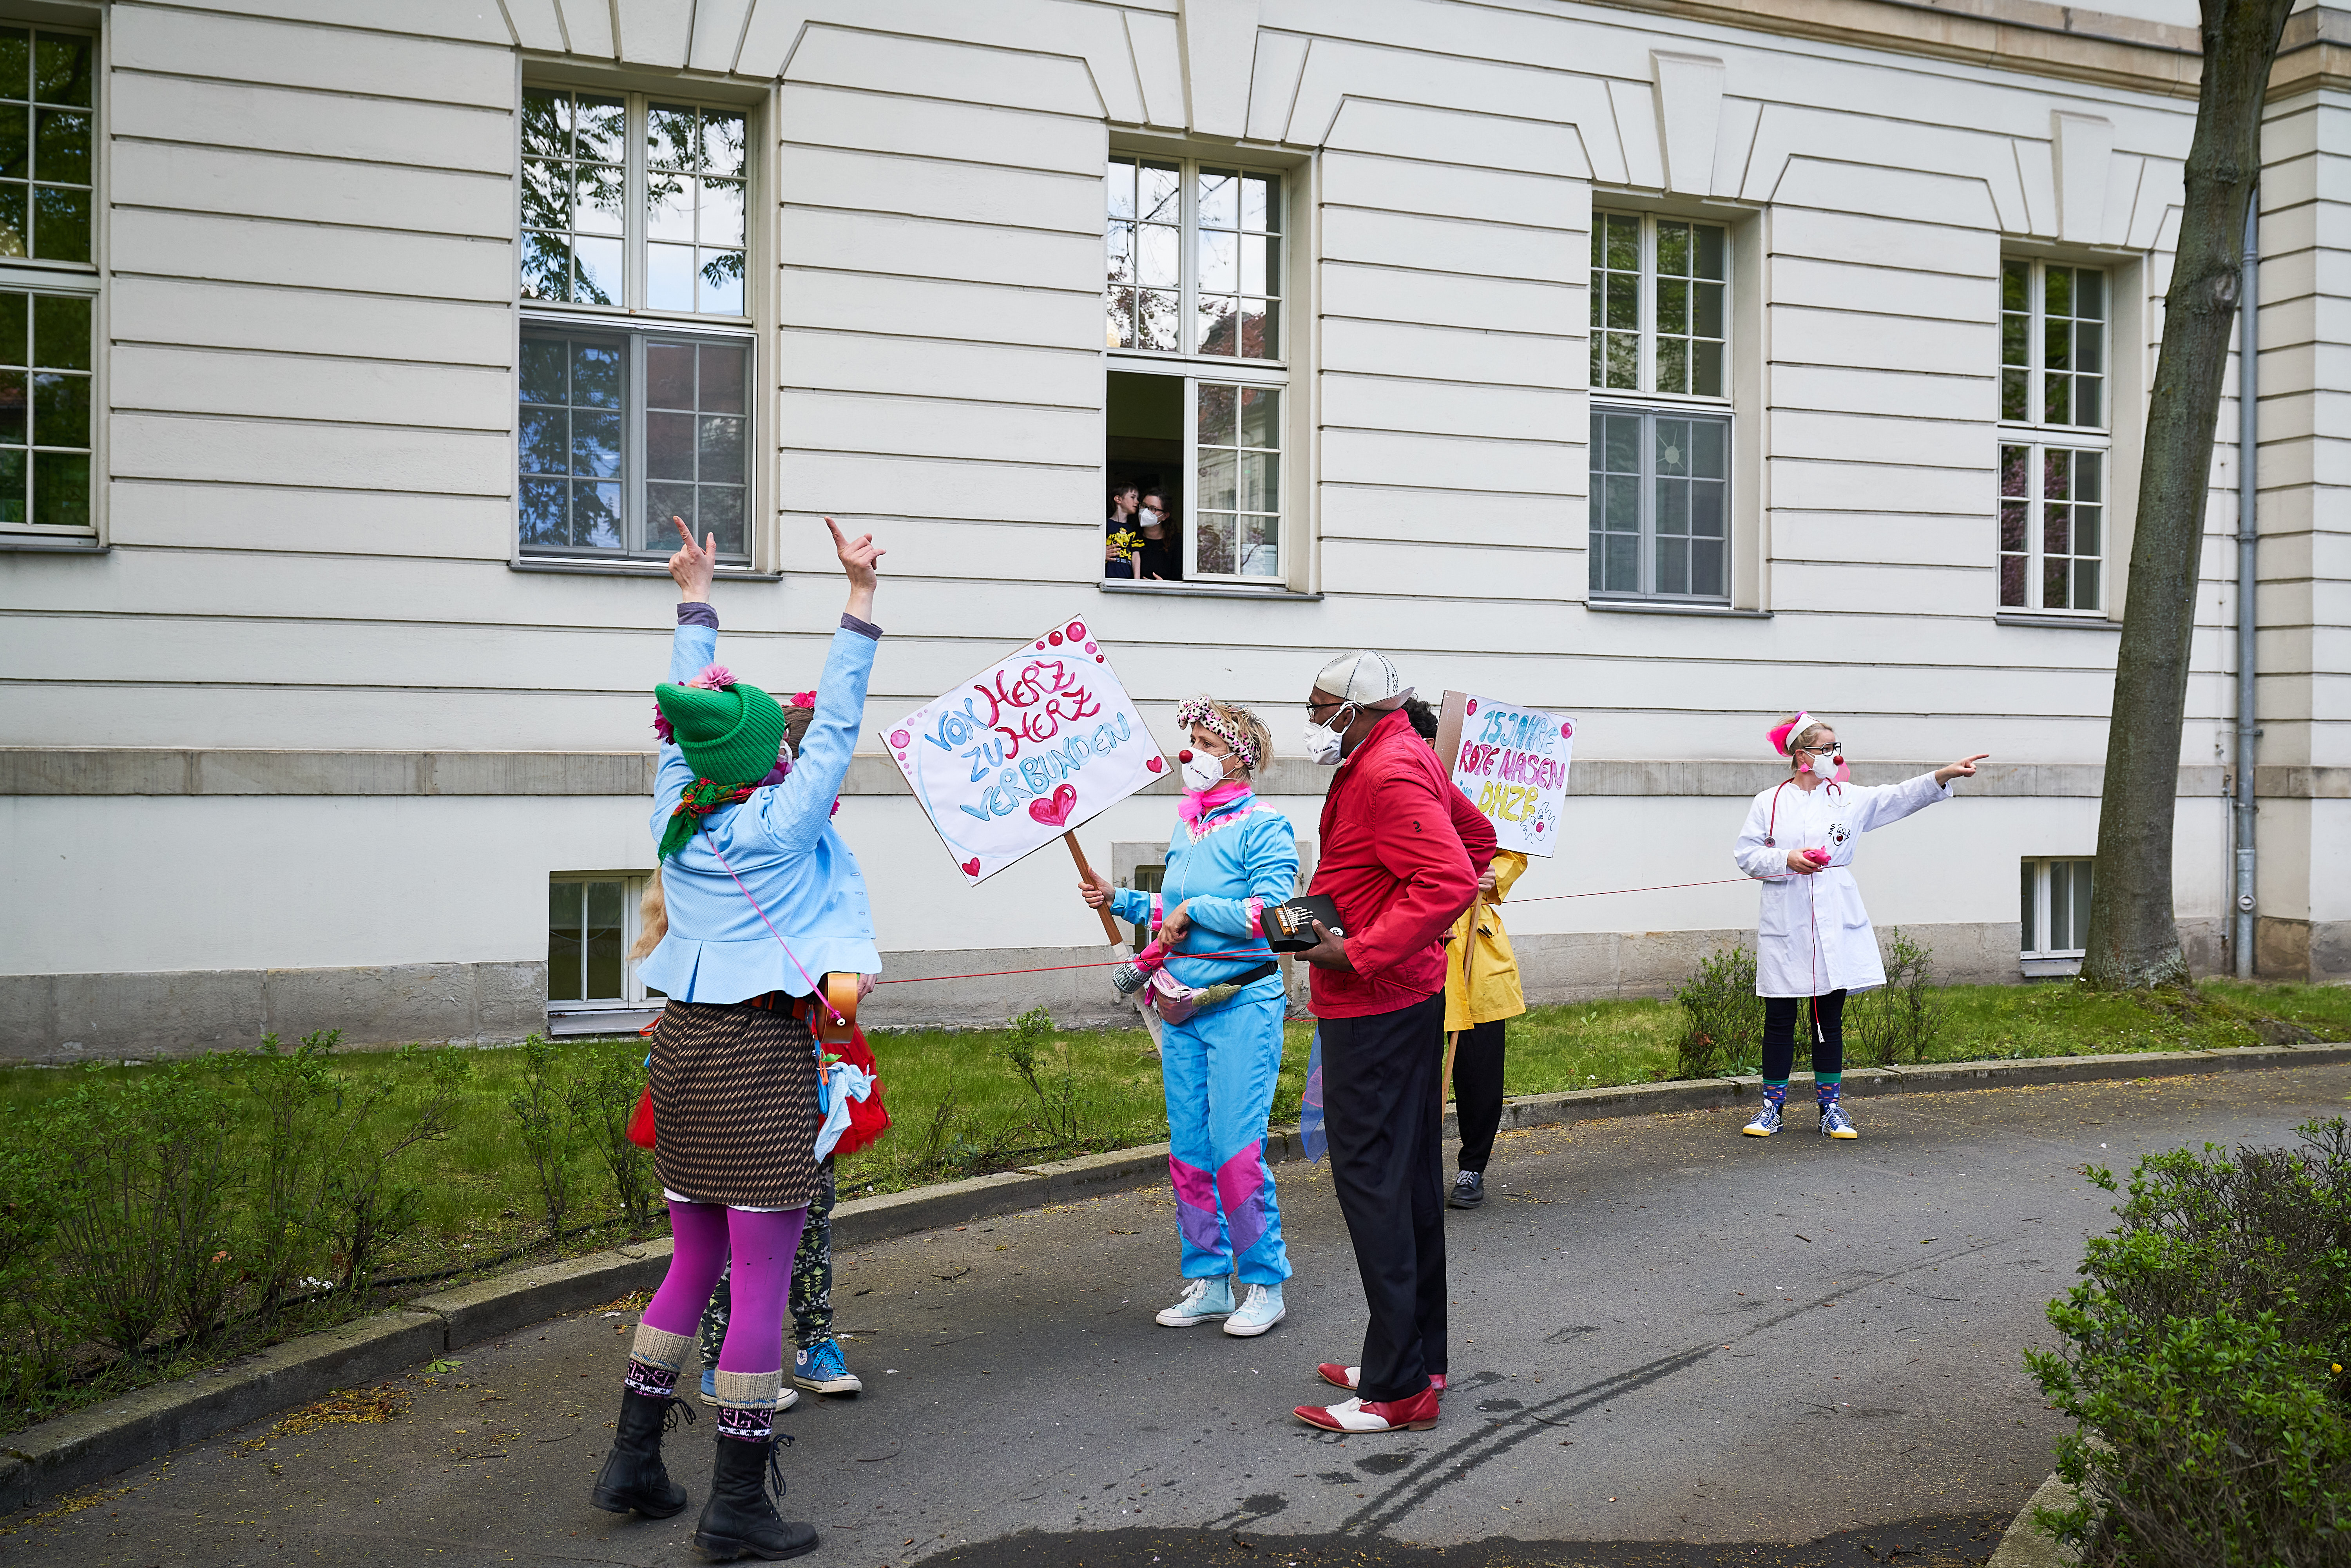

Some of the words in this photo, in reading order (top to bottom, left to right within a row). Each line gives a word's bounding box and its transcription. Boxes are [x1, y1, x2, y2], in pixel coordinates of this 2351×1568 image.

[925, 697, 989, 751] VON
[974, 660, 1076, 728] HERZ
[961, 737, 1002, 782] ZU
[994, 685, 1100, 759] HERZ
[1479, 710, 1507, 743] 15
[1500, 712, 1558, 754] JAHRE
[960, 712, 1130, 822] VERBUNDEN
[1458, 739, 1500, 776] ROTE
[1498, 748, 1565, 790] NASEN
